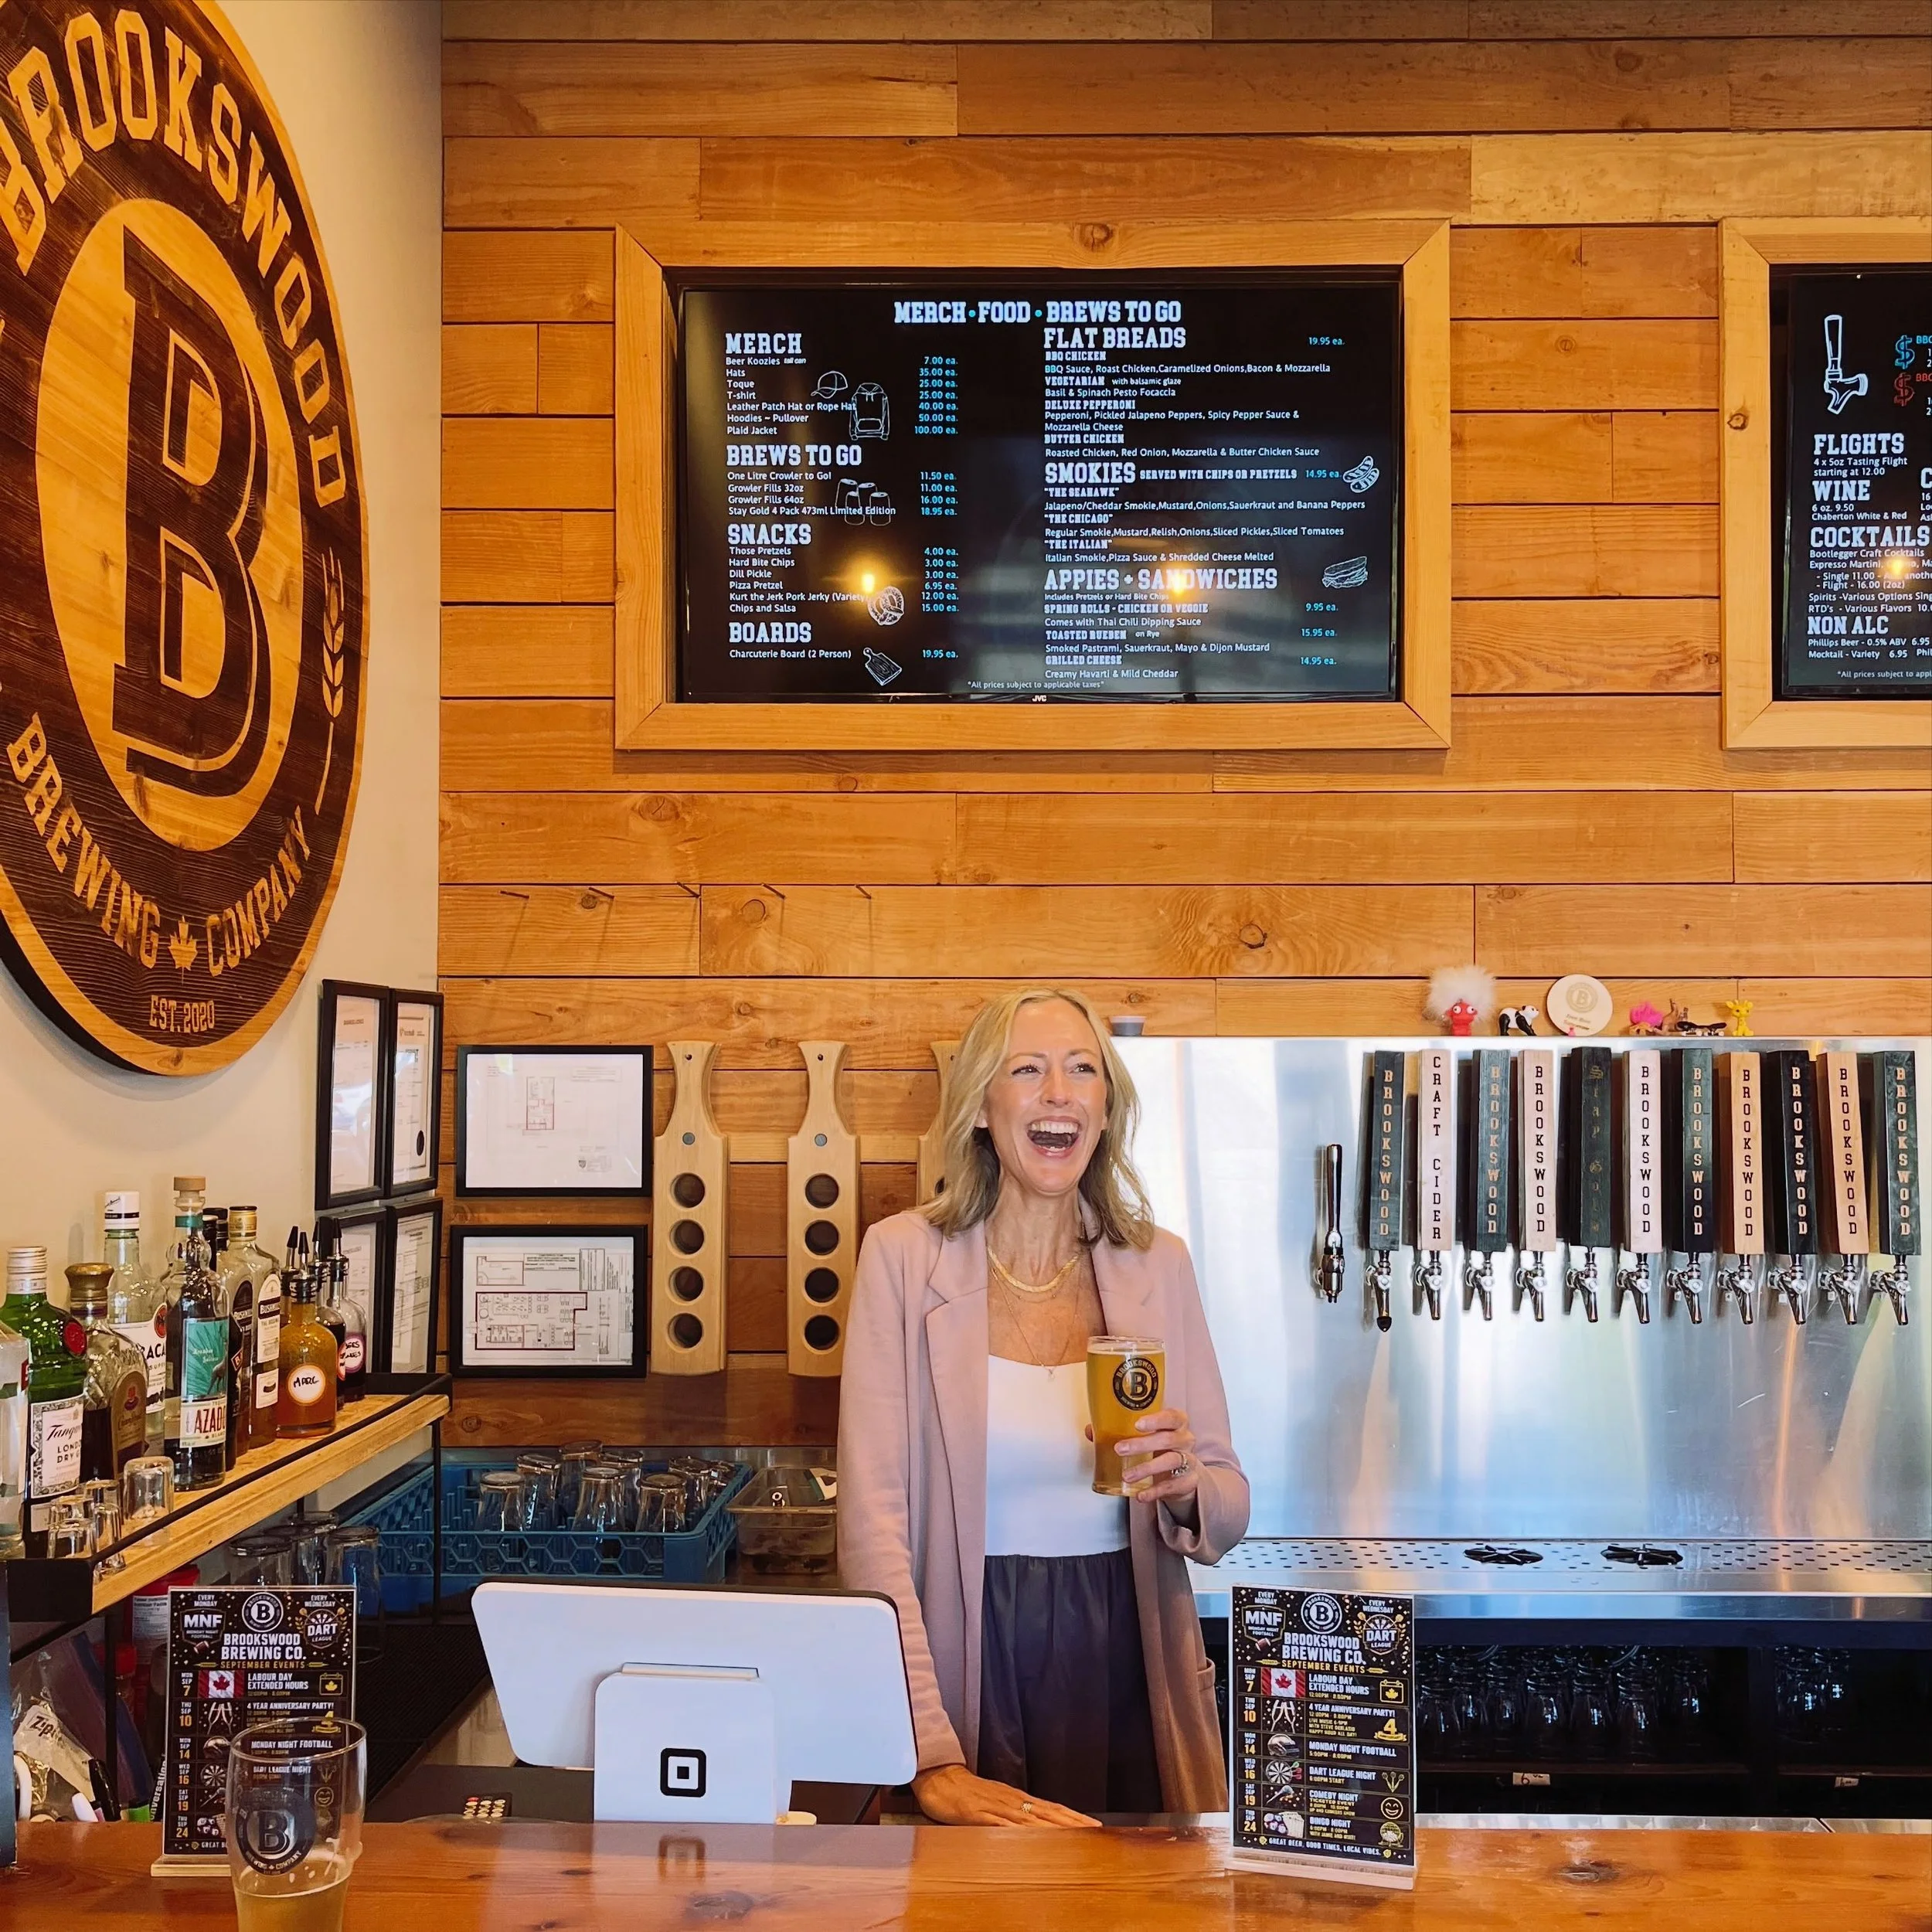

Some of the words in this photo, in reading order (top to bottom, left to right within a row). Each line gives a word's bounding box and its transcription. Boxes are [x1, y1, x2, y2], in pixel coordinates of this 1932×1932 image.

[0, 9, 347, 509] BROOKSWOOD
[893, 301, 967, 324] MERCH
[978, 301, 1031, 323] FOOD
[1046, 301, 1121, 323] BREWS
[1124, 300, 1151, 322] TO
[1155, 300, 1182, 322] GO
[725, 332, 802, 355] MERCH
[1043, 327, 1098, 349] FLAT
[1102, 326, 1186, 349] BREADS
[1308, 336, 1331, 345] 19.95
[726, 356, 746, 366] Beer
[747, 356, 781, 366] Koozies
[923, 355, 944, 365] 7.00
[945, 357, 958, 366] ea.
[726, 368, 746, 377] Hats
[726, 379, 755, 390] Toque
[726, 390, 757, 400] T-shirt
[1045, 388, 1066, 397] Basil
[1068, 388, 1075, 397] &
[1077, 388, 1111, 399] Spinach
[1113, 388, 1138, 397] Pesto
[1139, 387, 1176, 397] Focaccia
[726, 402, 760, 411] Leather
[761, 402, 786, 411] Patch
[787, 402, 804, 411] Hat
[816, 402, 839, 413] Rope
[841, 402, 856, 411] Hat
[726, 425, 749, 435] Plaid
[750, 426, 777, 435] Jacket
[1813, 433, 1905, 456] FLIGHTS
[726, 444, 801, 466] BREWS
[804, 444, 832, 466] TO
[835, 444, 862, 466] GO
[1813, 457, 1820, 466] 4
[1828, 457, 1845, 467] 5oz
[1846, 457, 1879, 468] Tasting
[1882, 457, 1908, 468] Flight
[726, 471, 746, 481] One
[747, 471, 767, 481] Litre
[769, 471, 804, 481] Crowler
[804, 471, 815, 481] to
[816, 471, 832, 481] Go!
[1045, 461, 1136, 484] SMOKIES
[1813, 468, 1849, 478] starting
[1849, 468, 1859, 476] at
[1862, 466, 1886, 476] 12.00
[1811, 479, 1871, 502] WINE
[112, 224, 271, 798] B
[1811, 512, 1855, 521] Chaberton
[1855, 512, 1881, 520] White
[1883, 512, 1889, 520] &
[1891, 511, 1907, 520] Red
[727, 523, 811, 545] SNACKS
[1810, 526, 1930, 548] COCKTAILS
[729, 546, 756, 556] Those
[757, 546, 792, 556] Pretzels
[729, 557, 750, 566] Hard
[751, 557, 769, 567] Bite
[770, 557, 795, 569] Chips
[1043, 569, 1120, 590] APPIES
[1138, 567, 1278, 590] SANDWICHES
[729, 604, 754, 614] Chips
[755, 604, 772, 613] and
[774, 604, 797, 613] Salsa
[728, 621, 811, 643] BOARDS
[1807, 615, 1848, 635] NON
[1851, 615, 1889, 634] ALC
[729, 649, 779, 658] Charcuterie
[780, 649, 806, 658] Board
[808, 649, 817, 659] (2
[818, 649, 852, 659] Person)
[922, 649, 944, 658] 19.95
[1032, 694, 1047, 702] JVC
[6, 711, 162, 971] BREWING
[206, 804, 311, 978] COMPANY
[1432, 1056, 1442, 1137] CRAFT
[1379, 1070, 1394, 1236] BROOKSWOOD
[1488, 1065, 1502, 1234] BROOKSWOOD
[1534, 1066, 1546, 1233] BROOKSWOOD
[1640, 1066, 1652, 1233] BROOKSWOOD
[1692, 1067, 1705, 1236] BROOKSWOOD
[1742, 1069, 1754, 1236] BROOKSWOOD
[1791, 1066, 1808, 1235] BROOKSWOOD
[1839, 1067, 1857, 1235] BROOKSWOOD
[1896, 1067, 1911, 1236] BROOKSWOOD
[1432, 1158, 1442, 1240] CIDER
[1130, 1371, 1148, 1399] B
[184, 1614, 223, 1628] MNF
[1245, 1611, 1283, 1626] MNF
[1315, 1604, 1329, 1623] B
[307, 1622, 338, 1638] DART
[1366, 1630, 1397, 1642] DART
[223, 1633, 301, 1647] BROOKSWOOD
[1284, 1632, 1360, 1650] BROOKSWOOD
[221, 1646, 282, 1661] BREWING
[285, 1646, 308, 1661] CO.
[1281, 1645, 1342, 1662] BREWING
[1345, 1650, 1367, 1665] CO.
[220, 1661, 271, 1669] SEPTEMBER
[273, 1661, 306, 1669] EVENTS
[1281, 1659, 1331, 1672] SEPTEMBER
[1333, 1664, 1366, 1674] EVENTS
[1308, 1673, 1337, 1684] LABOUR
[1338, 1675, 1353, 1685] DAY
[182, 1685, 191, 1696] 7
[1246, 1681, 1254, 1693] 7
[1308, 1682, 1344, 1693] EXTENDED
[1345, 1685, 1369, 1696] HOURS
[1243, 1709, 1257, 1723] 10
[1314, 1704, 1330, 1713] YEAR
[1373, 1709, 1396, 1718] PARTY!
[179, 1715, 192, 1727] 10
[1383, 1718, 1397, 1733] 4
[1244, 1743, 1256, 1755] 14
[1309, 1740, 1338, 1752] MONDAY
[1338, 1743, 1360, 1753] NIGHT
[1362, 1746, 1396, 1757] FOOTBALL
[1244, 1770, 1256, 1780] 16
[1309, 1767, 1328, 1777] DART
[1328, 1768, 1355, 1779] LEAGUE
[1355, 1770, 1376, 1781] NIGHT
[1244, 1794, 1256, 1806] 19
[1309, 1790, 1337, 1801] COMEDY
[1338, 1792, 1359, 1802] NIGHT
[176, 1827, 189, 1838] 24
[259, 1811, 291, 1855] B
[1243, 1821, 1257, 1832] 24
